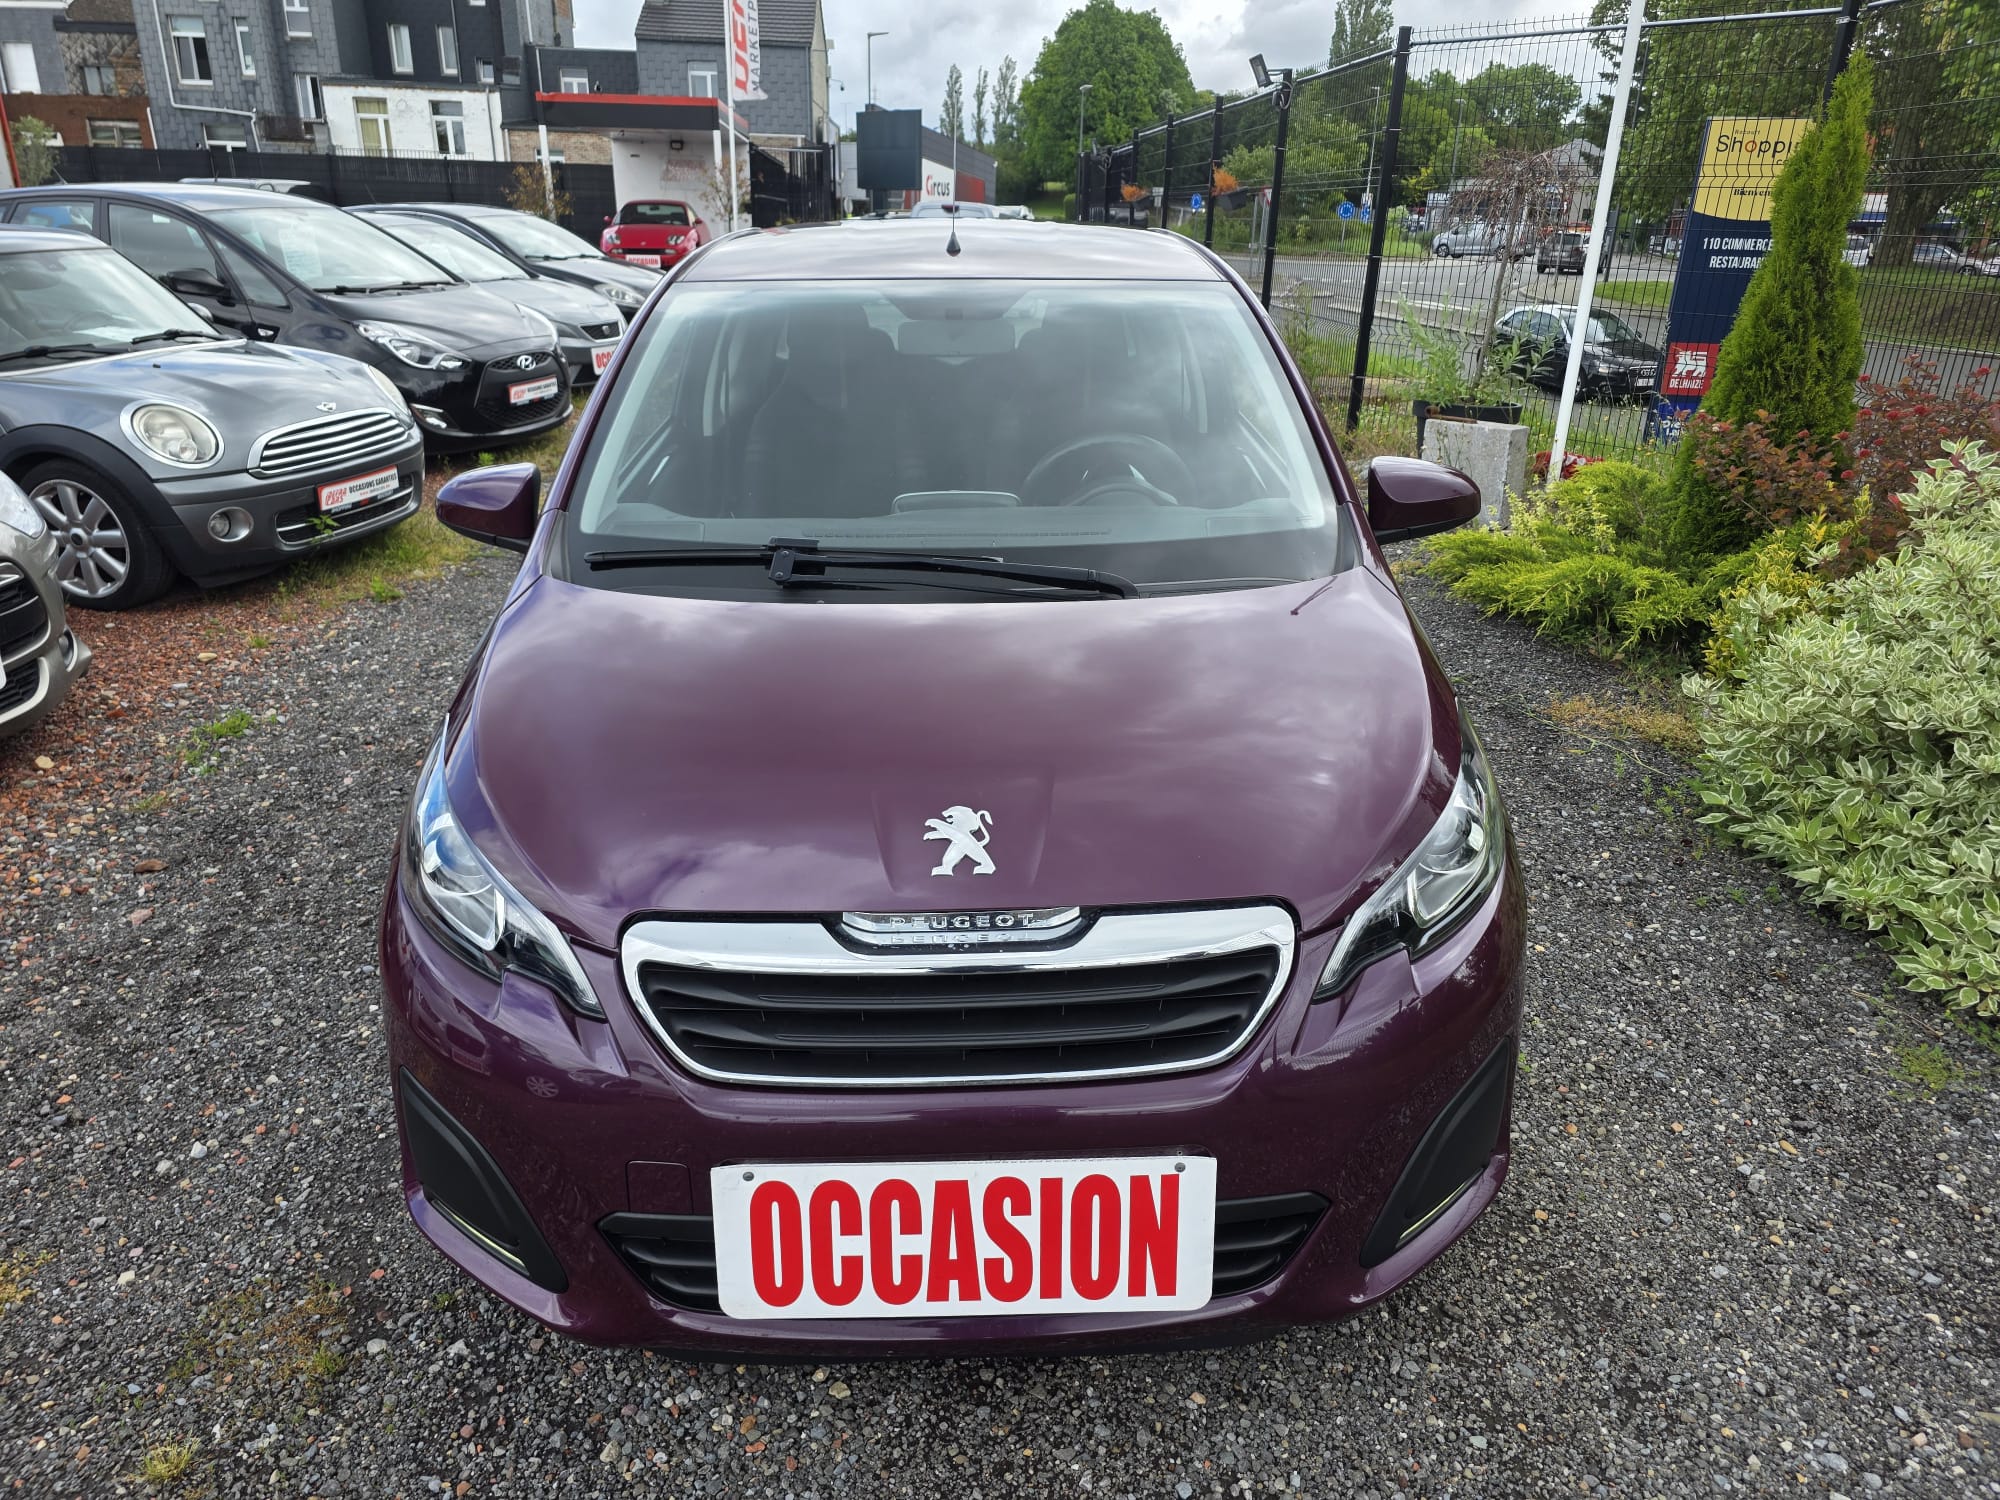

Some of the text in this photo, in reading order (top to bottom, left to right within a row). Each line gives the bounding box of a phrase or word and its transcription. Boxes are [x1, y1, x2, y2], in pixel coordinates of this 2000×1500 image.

[926, 175, 950, 197] Circus
[1703, 237, 1721, 250] 110
[1669, 378, 1705, 389] DELHAIZE
[889, 913, 1034, 929] PEUGEOT
[749, 1173, 1180, 1307] OCCASION
